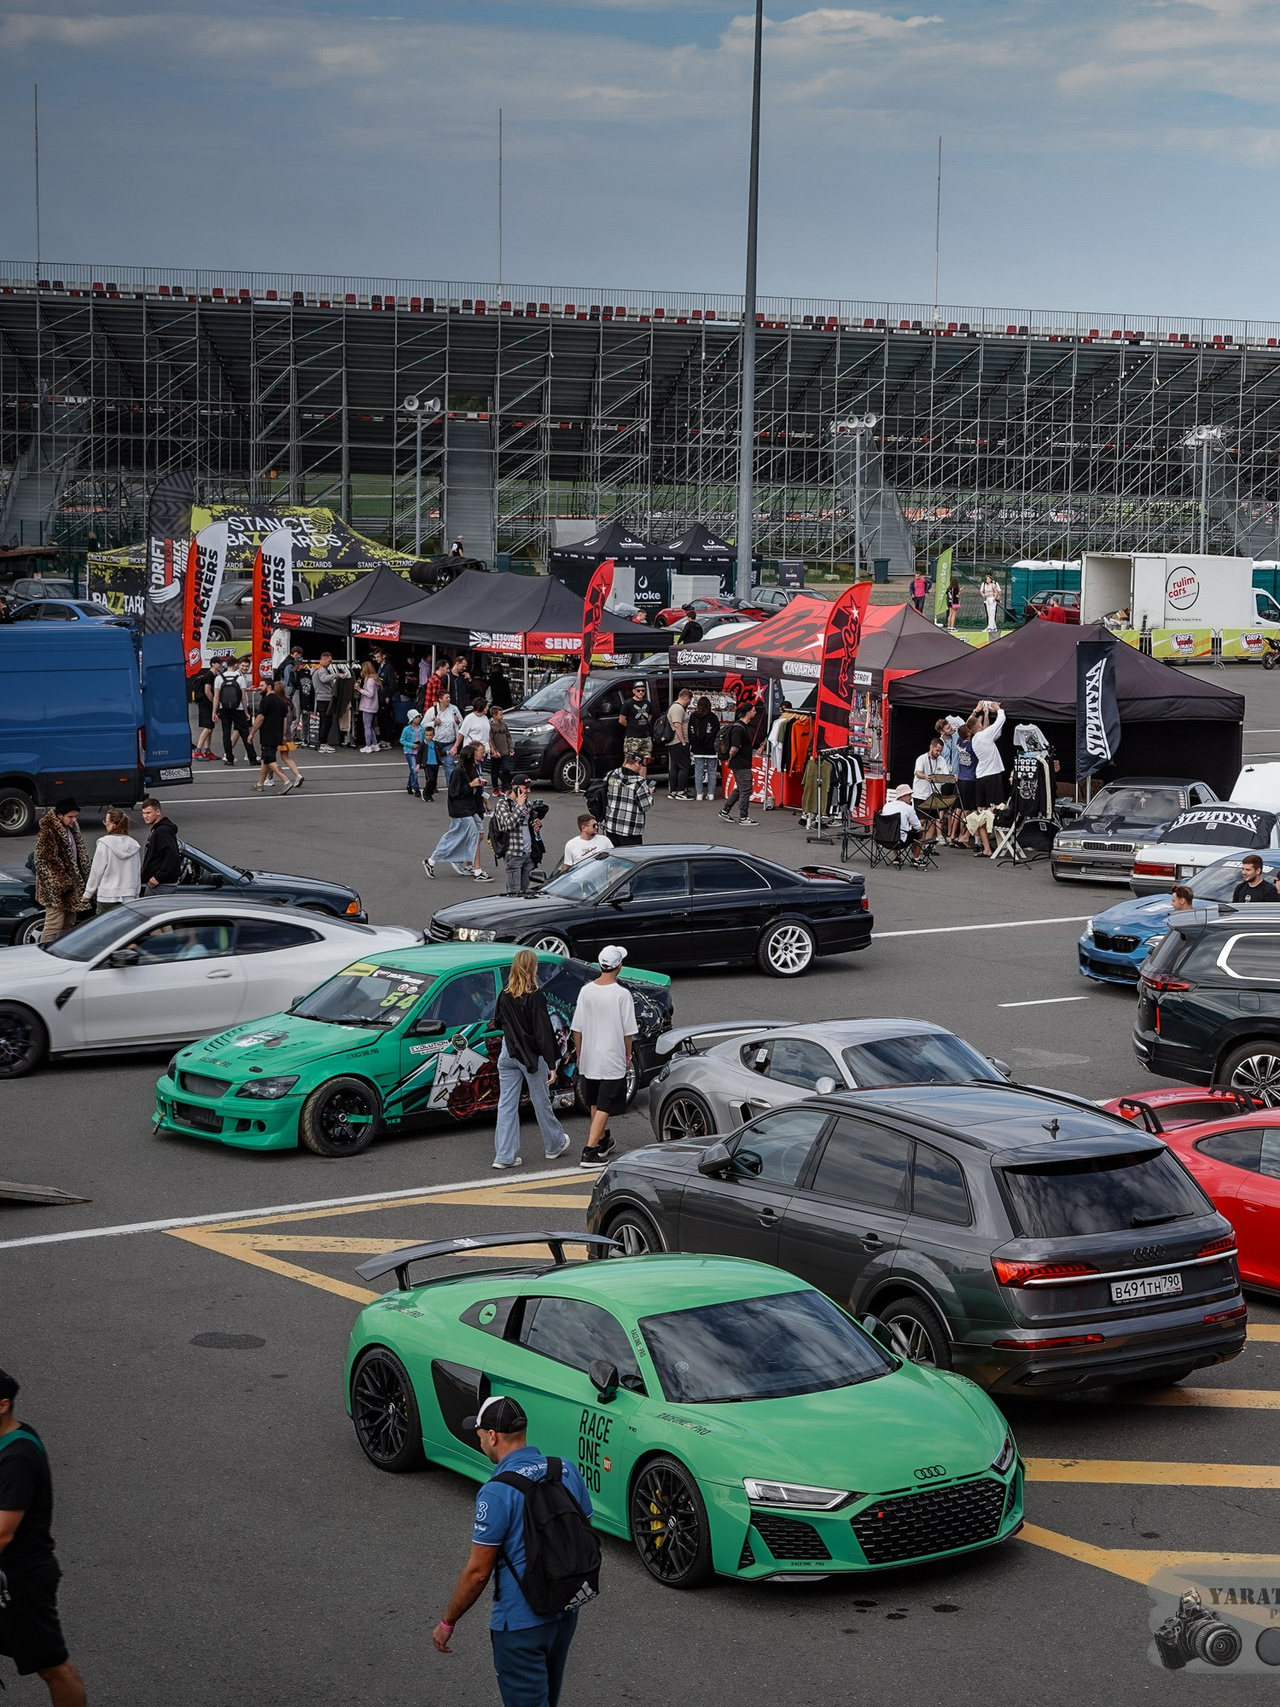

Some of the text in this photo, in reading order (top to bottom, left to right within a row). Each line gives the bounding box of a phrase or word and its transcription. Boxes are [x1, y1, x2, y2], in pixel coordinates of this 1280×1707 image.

[228, 516, 317, 533] STANCE
[227, 532, 342, 547] BAZARDS
[151, 537, 165, 586] DRIFT
[172, 540, 182, 577] TRACK
[181, 538, 189, 573] MODE
[296, 560, 332, 568] BAZZTARDS
[1173, 576, 1195, 588] rulim
[1168, 587, 1187, 598] cars
[261, 553, 272, 653] RESOURCE
[491, 640, 522, 650] STICKERS
[545, 637, 582, 649] SENP
[213, 649, 235, 658] DRIFT
[693, 654, 711, 664] SHOP
[380, 991, 420, 1010] 54
[410, 1040, 450, 1052] EVOLUTION
[579, 1408, 614, 1444] RACE
[578, 1436, 601, 1468] ONE
[476, 1501, 489, 1522] 3
